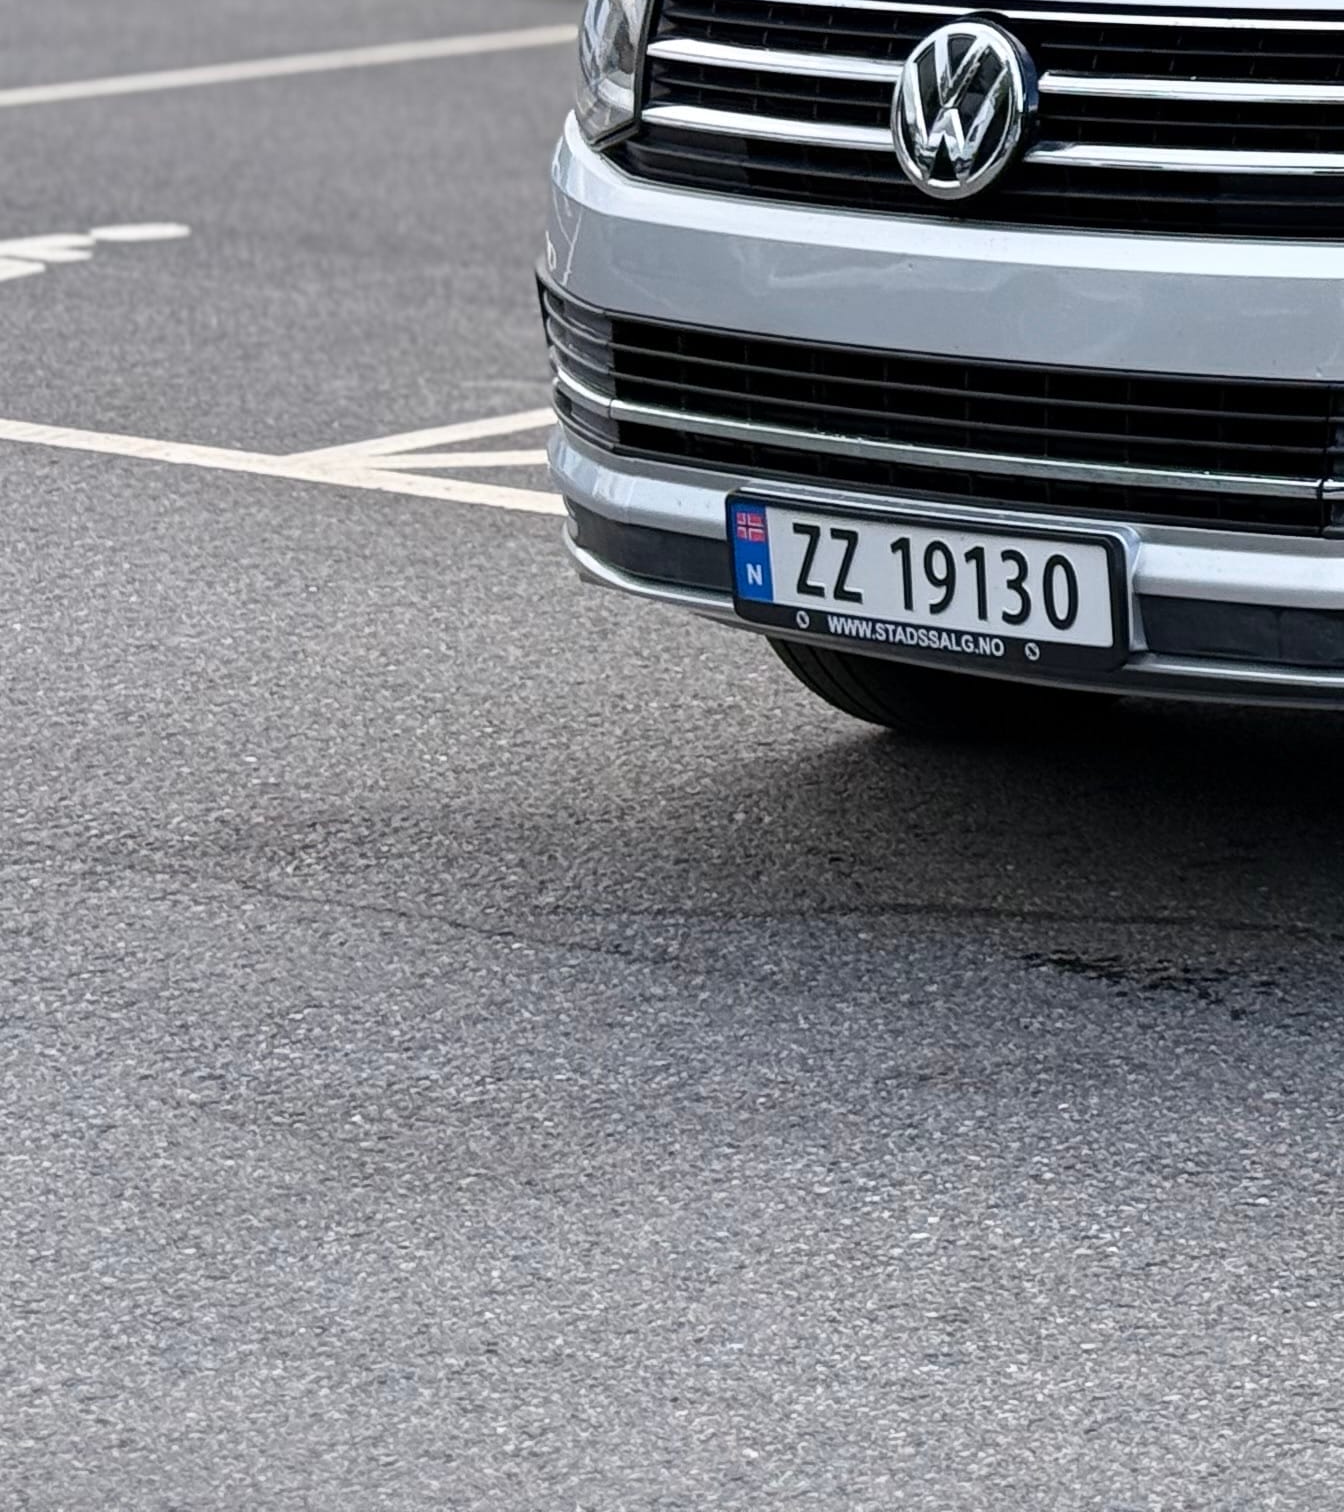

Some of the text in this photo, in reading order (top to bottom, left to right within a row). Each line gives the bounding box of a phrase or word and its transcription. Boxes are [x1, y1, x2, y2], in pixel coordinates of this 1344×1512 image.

[746, 563, 763, 587] N
[792, 521, 1079, 631] ZZ 19130
[828, 615, 1005, 658] WWW.STADSSALG.NO
